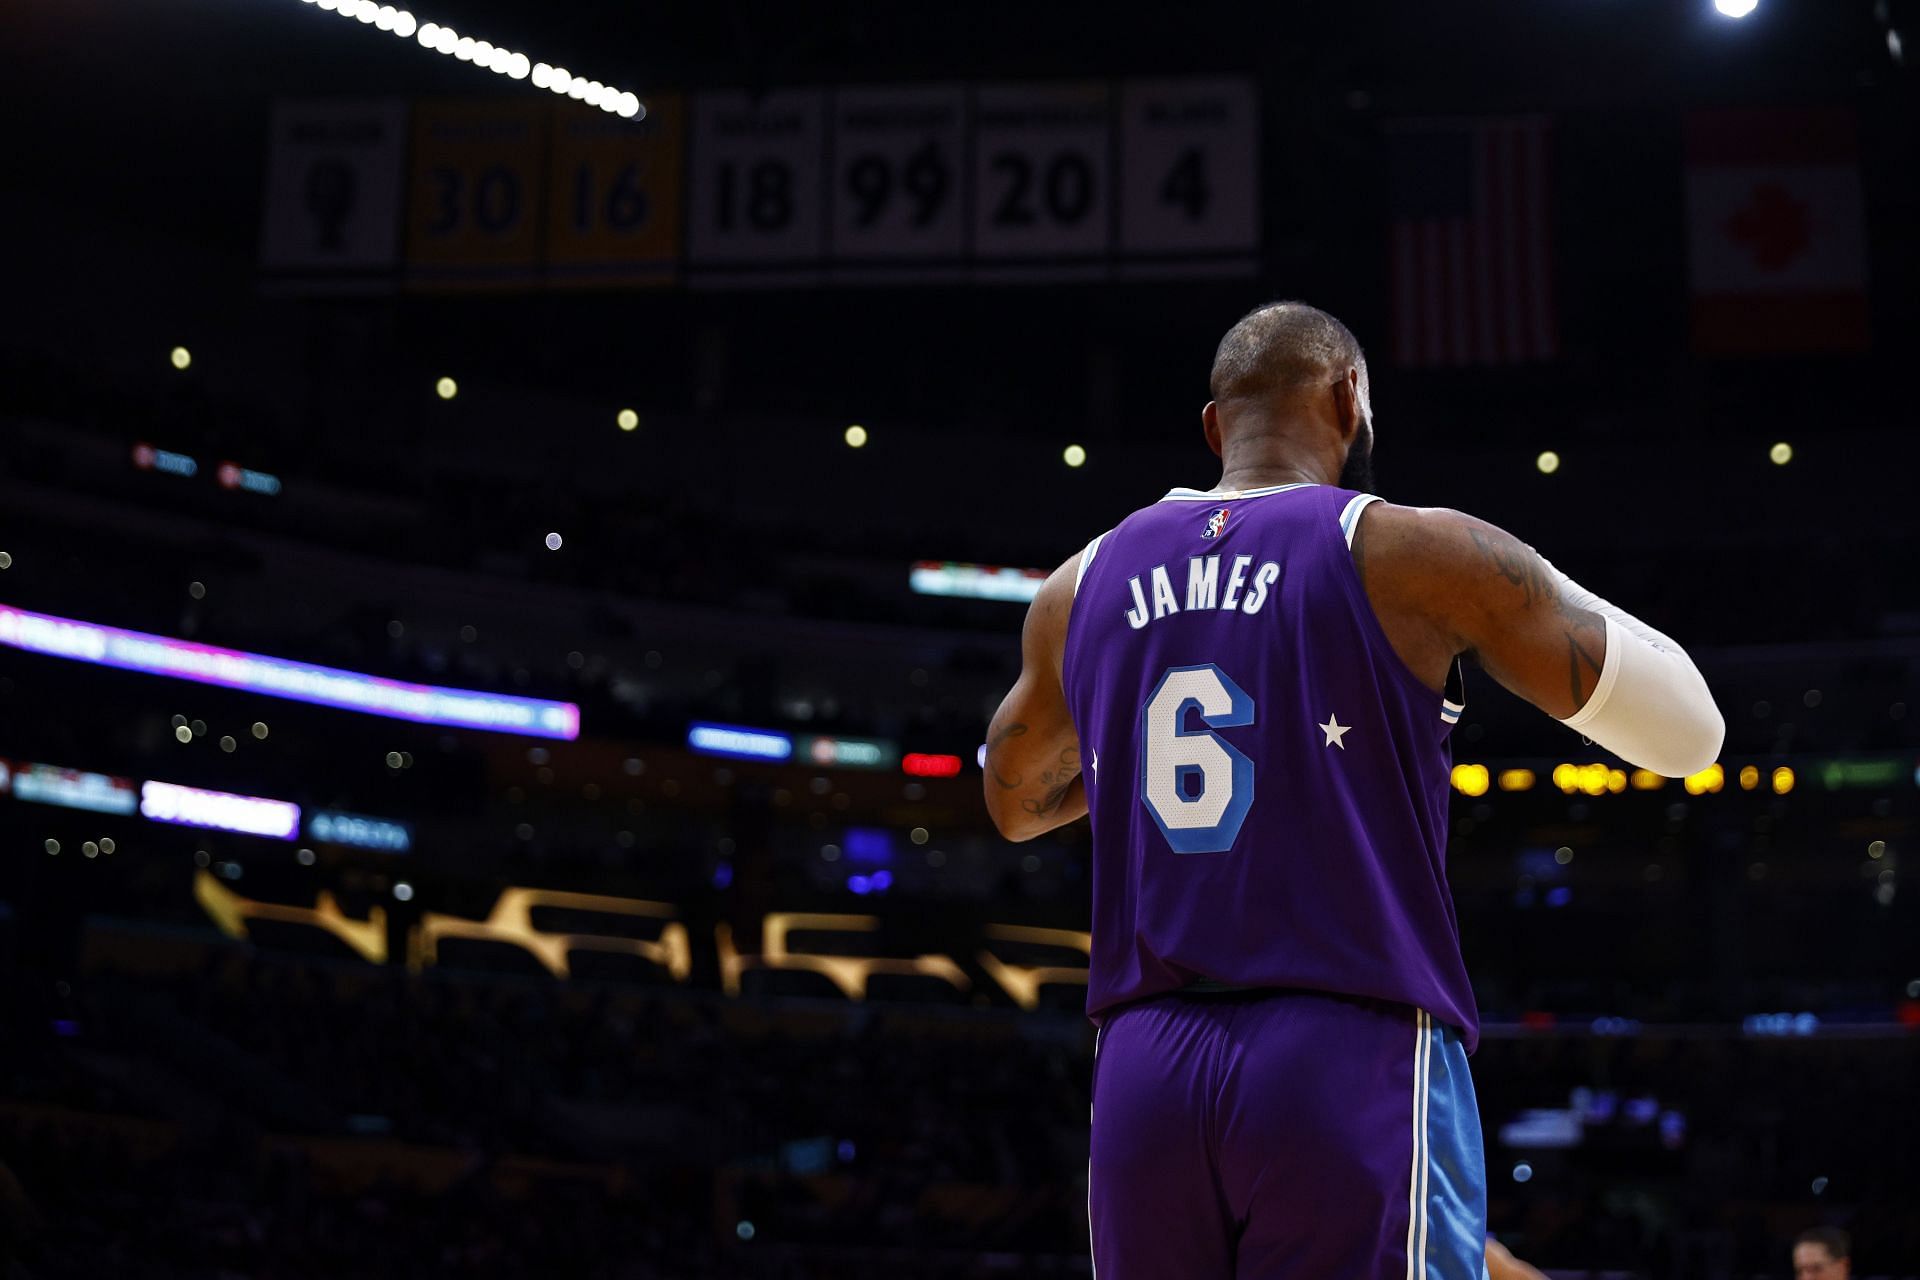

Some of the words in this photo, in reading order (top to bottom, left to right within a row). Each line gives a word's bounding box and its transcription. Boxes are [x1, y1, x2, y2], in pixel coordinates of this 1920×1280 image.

[425, 163, 520, 235] 30
[573, 161, 648, 232] 16
[717, 157, 795, 232] 18
[847, 149, 950, 229] 99
[989, 148, 1097, 229] 20
[1158, 146, 1210, 222] 4
[1126, 554, 1281, 630] JAMES
[1141, 663, 1255, 854] 6
